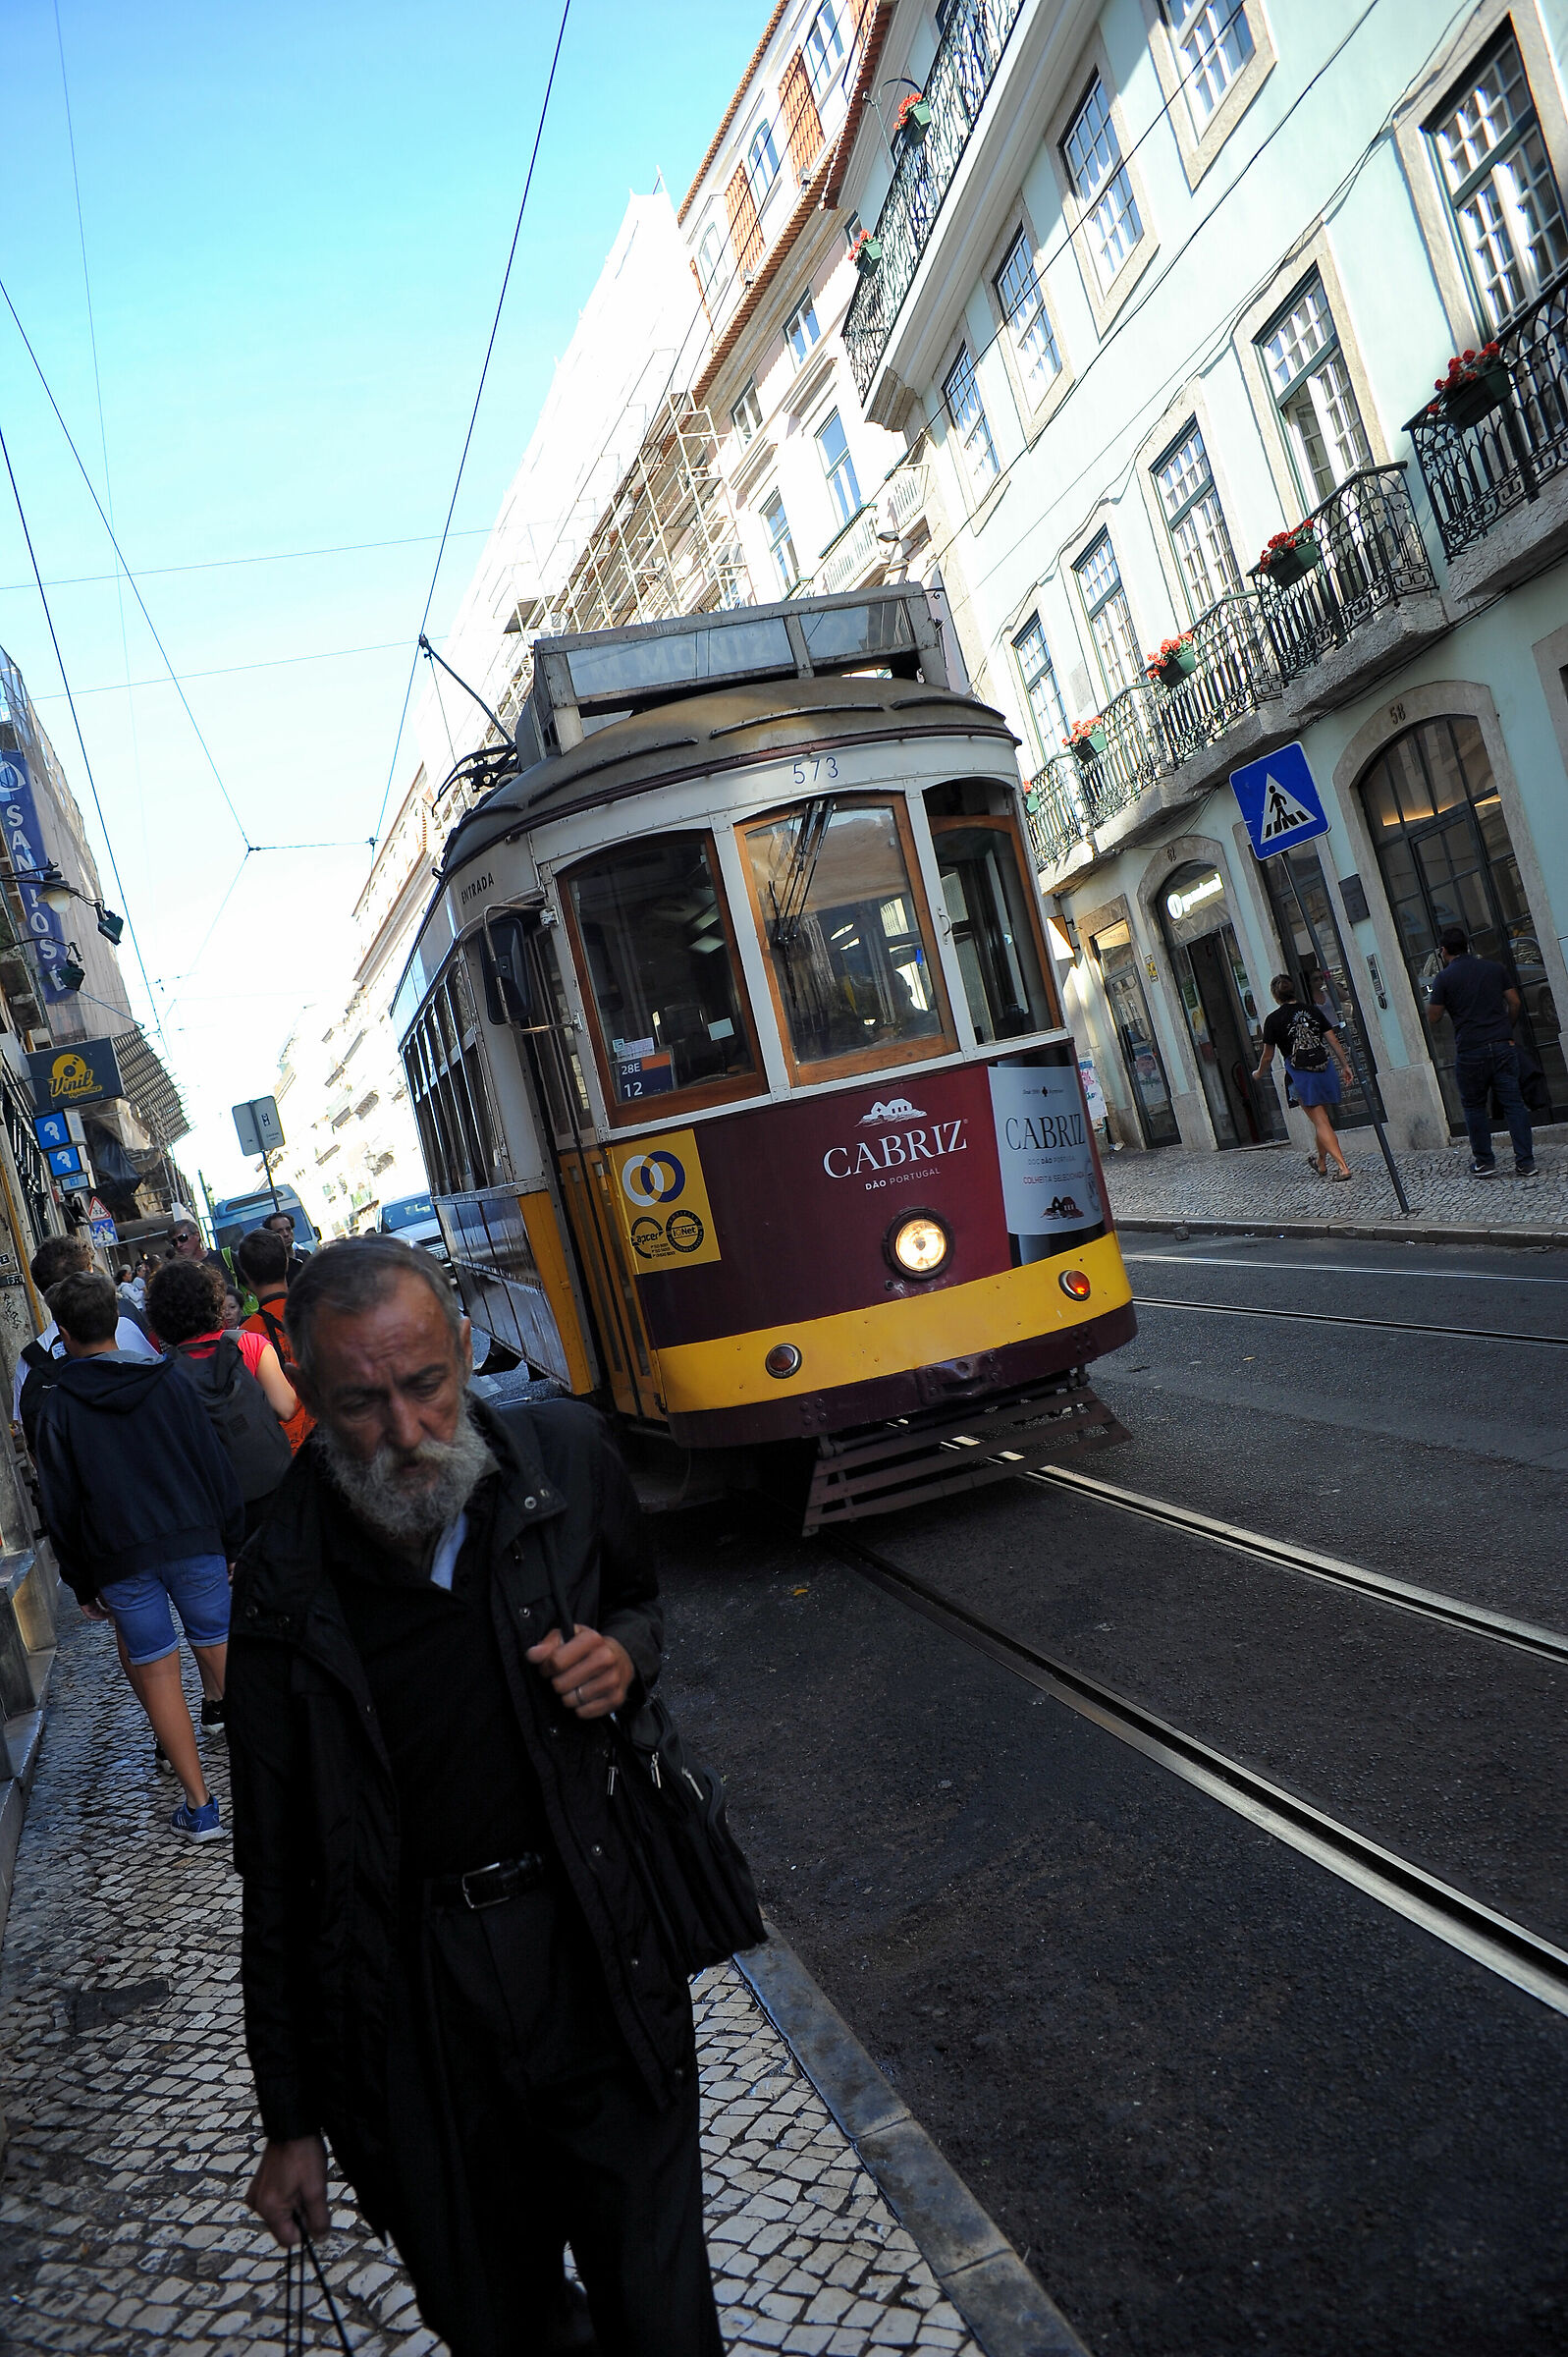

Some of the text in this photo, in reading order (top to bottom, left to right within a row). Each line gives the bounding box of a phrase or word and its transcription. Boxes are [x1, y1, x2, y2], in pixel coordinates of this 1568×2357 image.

[1389, 702, 1406, 725] 58
[793, 756, 838, 785] 573
[461, 872, 495, 904] ENTRADA
[49, 1069, 93, 1098] Vinil
[622, 1063, 641, 1075] 28E
[623, 1081, 643, 1097] 12
[1005, 1113, 1086, 1151] CABRIZ
[823, 1120, 968, 1178] CABRIZ
[865, 1167, 941, 1190] DÃO PORTUGAL
